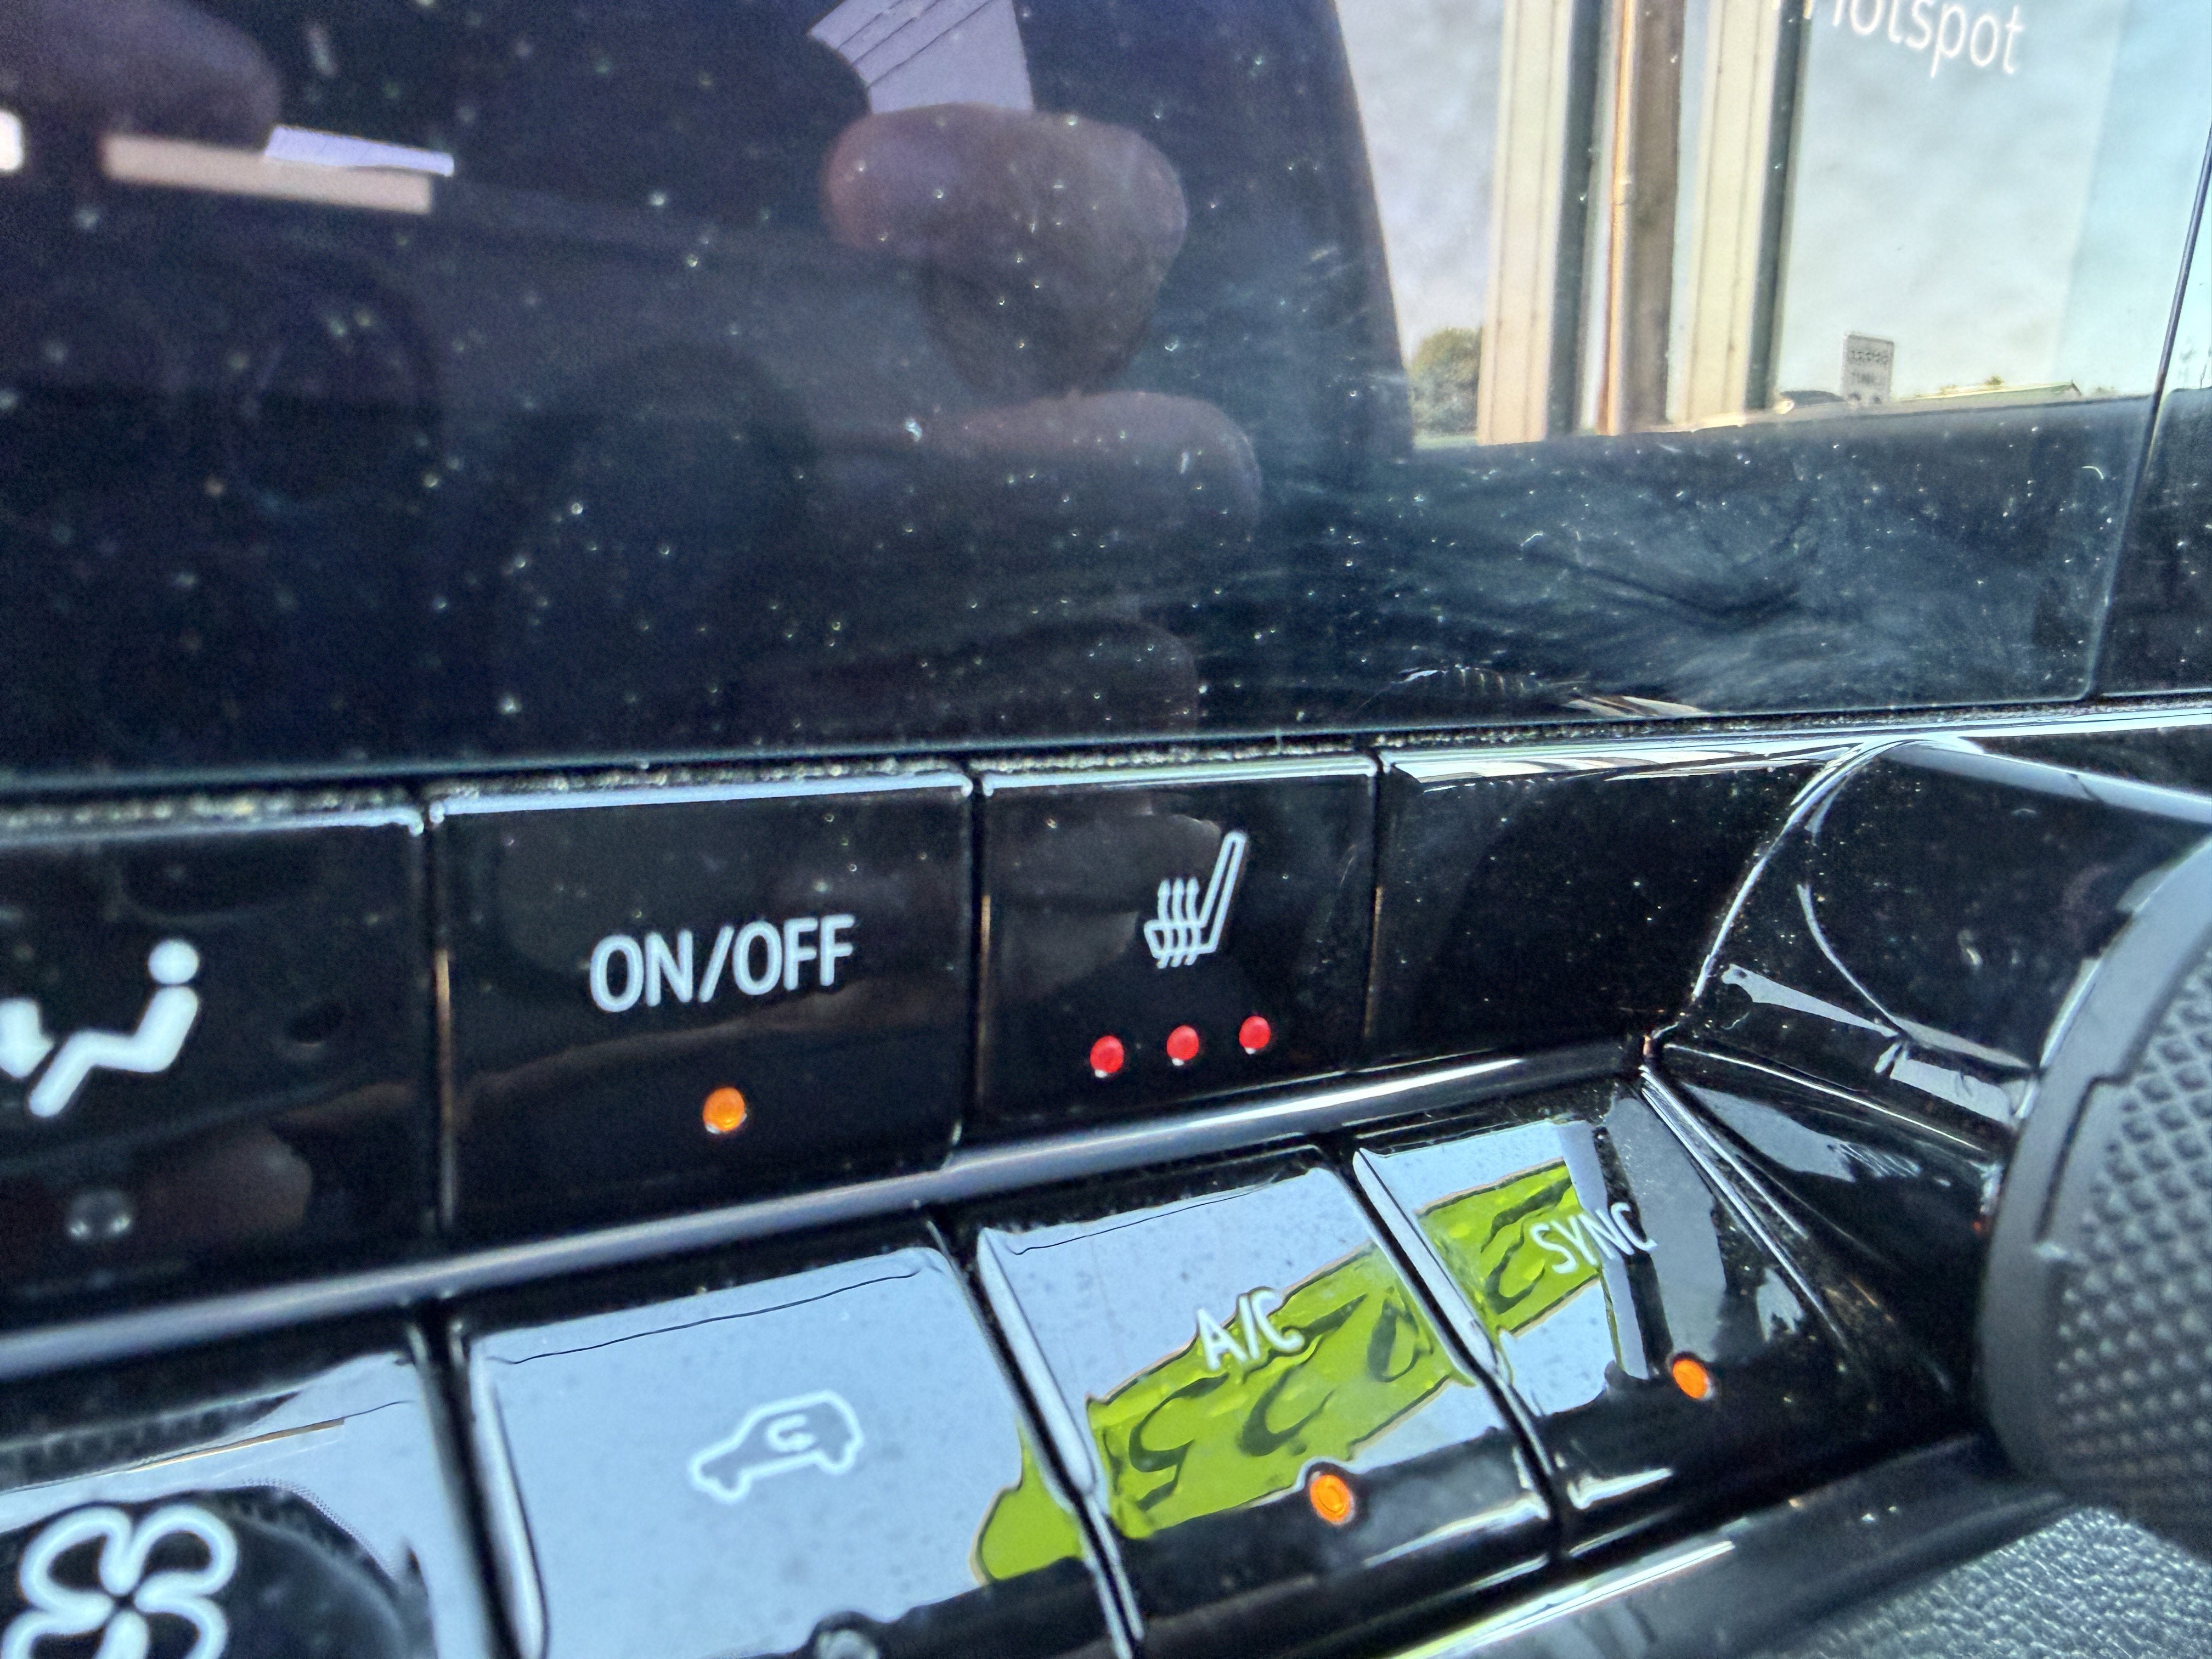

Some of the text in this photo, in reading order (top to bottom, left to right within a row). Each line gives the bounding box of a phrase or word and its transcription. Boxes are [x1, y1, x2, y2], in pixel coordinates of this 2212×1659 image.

[590, 914, 855, 1013] ON/OFF
[1530, 1202, 1657, 1273] SYNC
[1196, 1290, 1305, 1370] A/C
